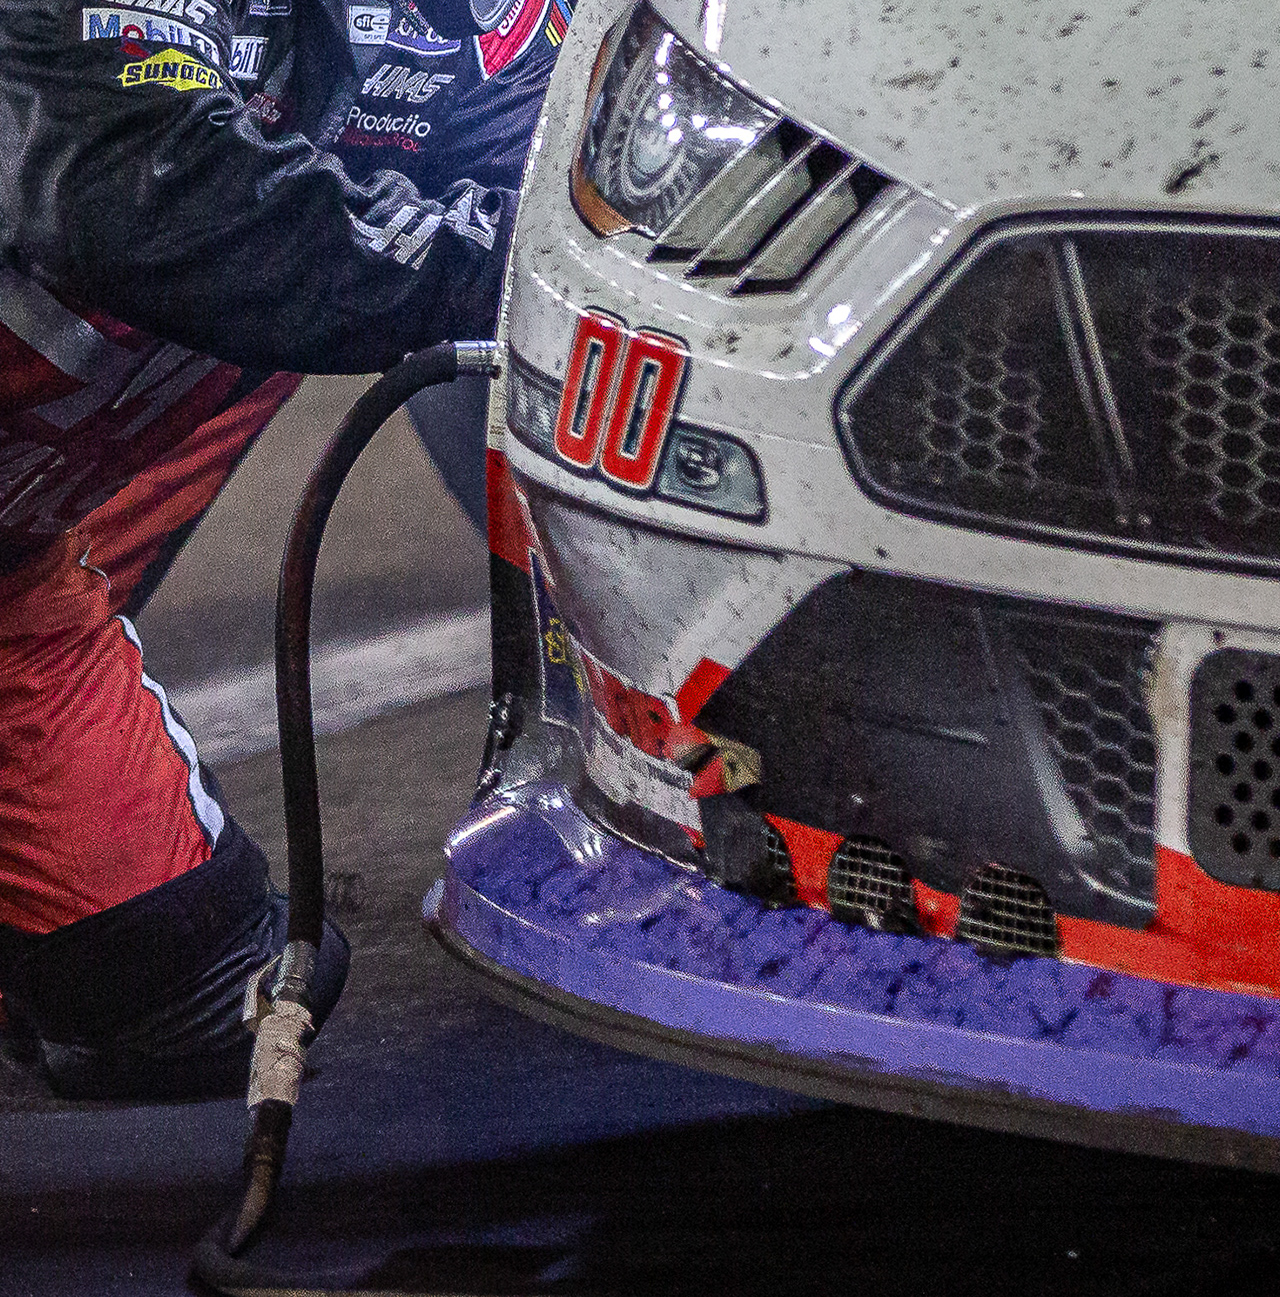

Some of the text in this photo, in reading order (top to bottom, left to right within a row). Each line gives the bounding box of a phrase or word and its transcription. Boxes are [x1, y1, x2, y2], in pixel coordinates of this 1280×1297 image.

[125, 62, 220, 89] SUNOCO
[361, 63, 456, 104] HAAS
[554, 306, 691, 491] 00
